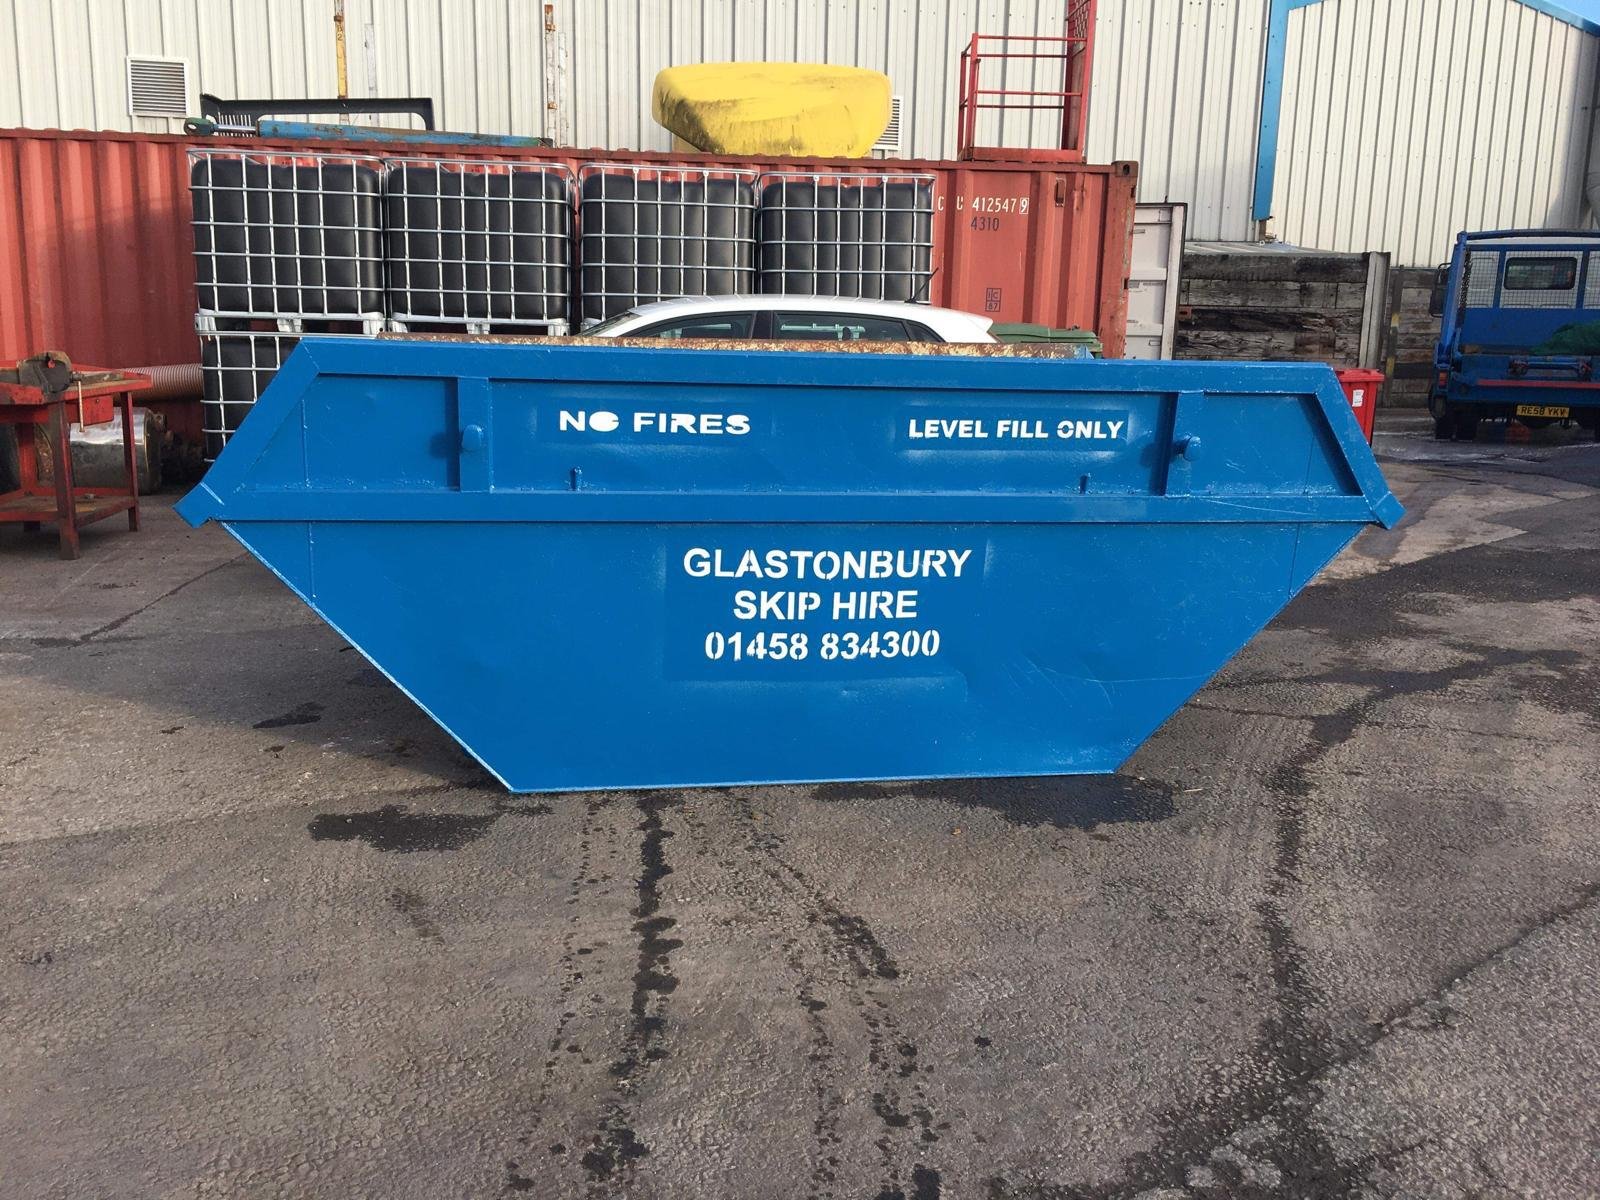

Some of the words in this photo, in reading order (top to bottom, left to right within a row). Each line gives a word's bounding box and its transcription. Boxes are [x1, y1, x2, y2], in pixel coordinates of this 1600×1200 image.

[971, 217, 1000, 231] 4310
[633, 412, 751, 435] FIRES
[908, 419, 989, 439] LEVEL
[996, 420, 1049, 439] FILL
[1056, 420, 1124, 439] ONLY
[683, 547, 972, 581] GLASTONBURY
[733, 590, 821, 620] SKIP
[832, 590, 918, 620] HIRE
[705, 631, 809, 661] 01458
[820, 629, 940, 660] 834300
